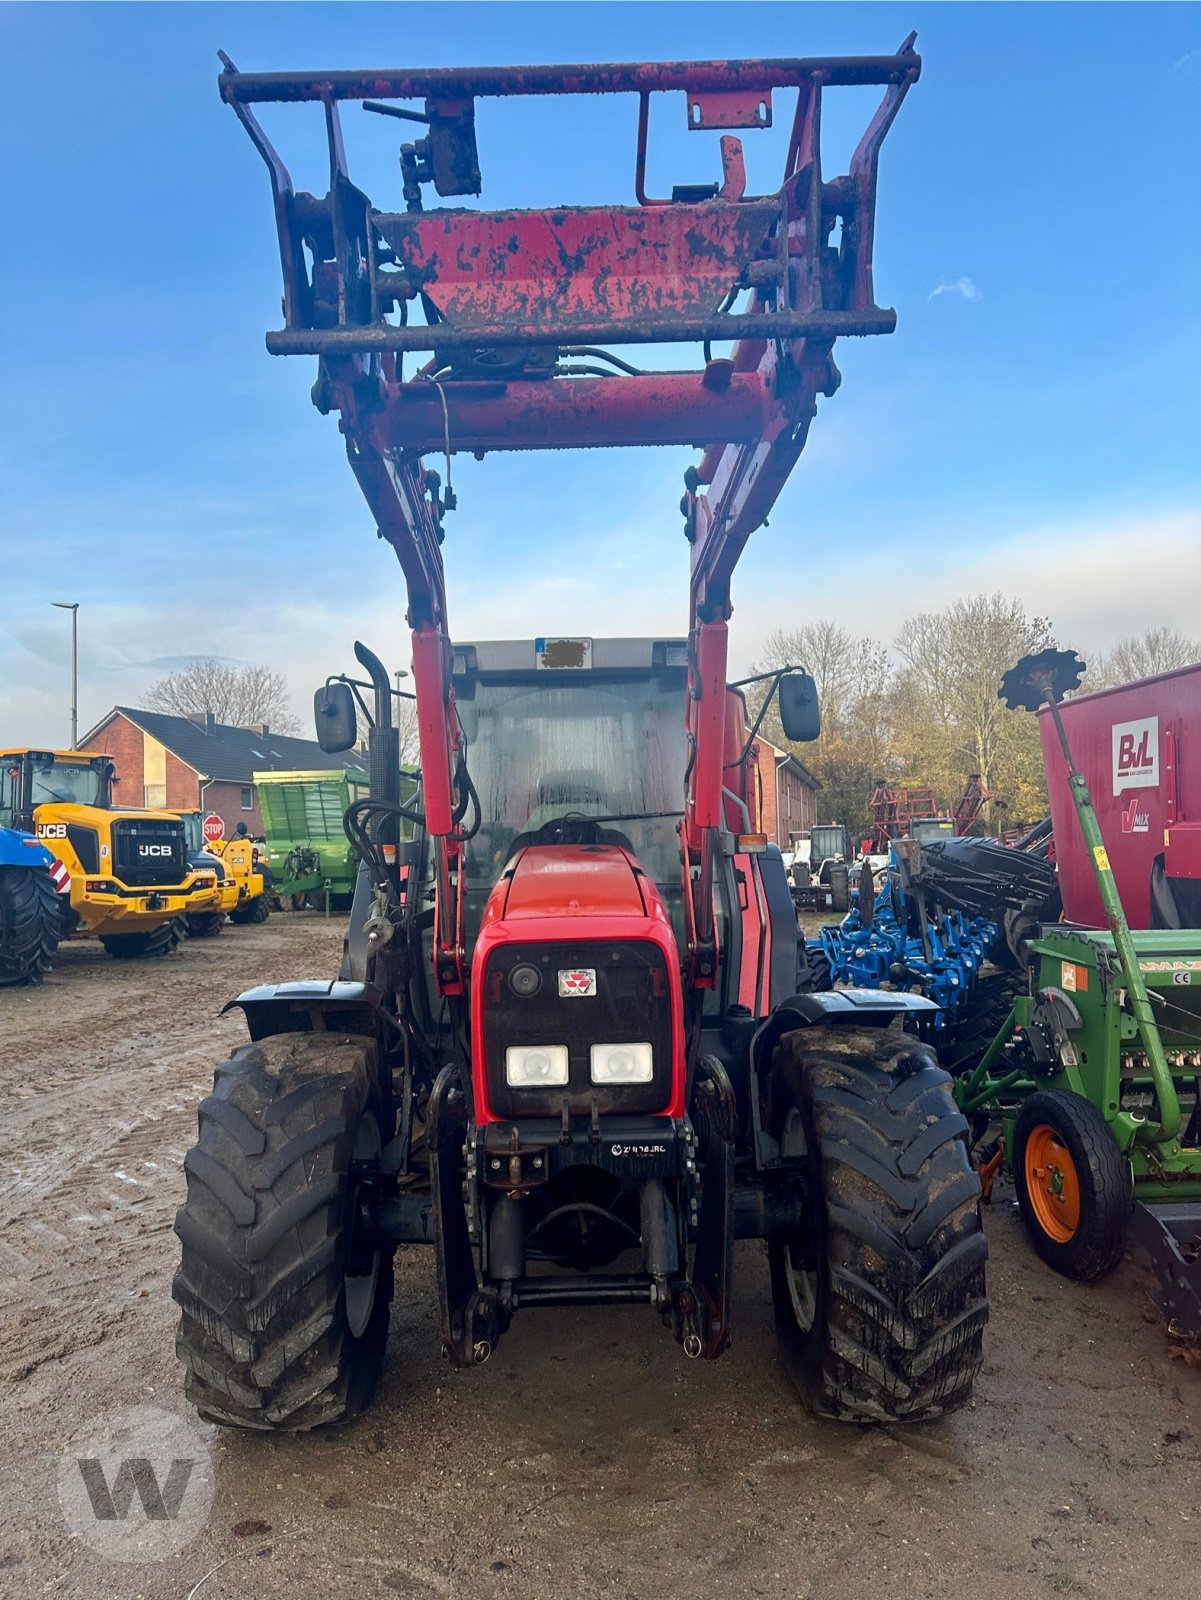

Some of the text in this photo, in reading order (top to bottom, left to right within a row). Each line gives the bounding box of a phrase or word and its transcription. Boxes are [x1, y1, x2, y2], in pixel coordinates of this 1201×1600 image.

[1118, 730, 1153, 769] BvL
[38, 824, 67, 839] JCB
[204, 823, 223, 834] STOP
[139, 845, 172, 857] JCB
[1174, 972, 1189, 984] CE
